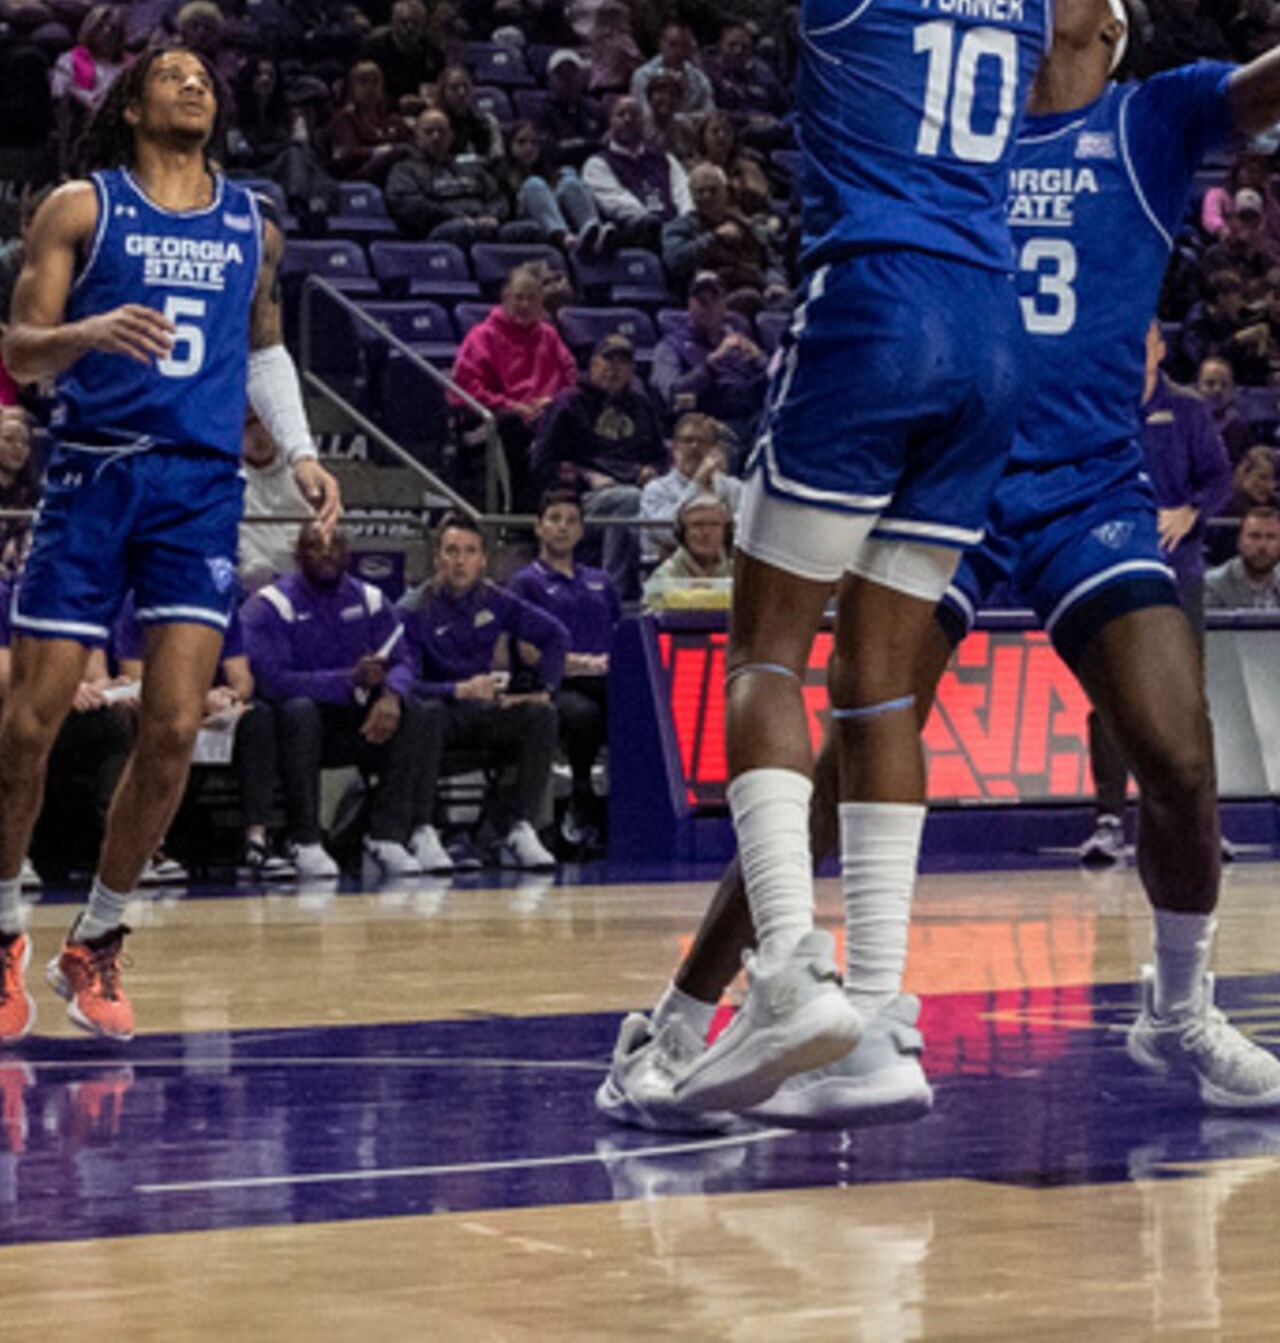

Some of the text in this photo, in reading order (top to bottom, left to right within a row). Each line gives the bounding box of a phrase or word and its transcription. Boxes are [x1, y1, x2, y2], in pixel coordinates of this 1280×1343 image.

[913, 19, 1018, 163] 10
[125, 234, 242, 264] GEORGIA
[144, 258, 224, 283] STATE
[1014, 238, 1078, 336] 3
[157, 295, 205, 377] 5
